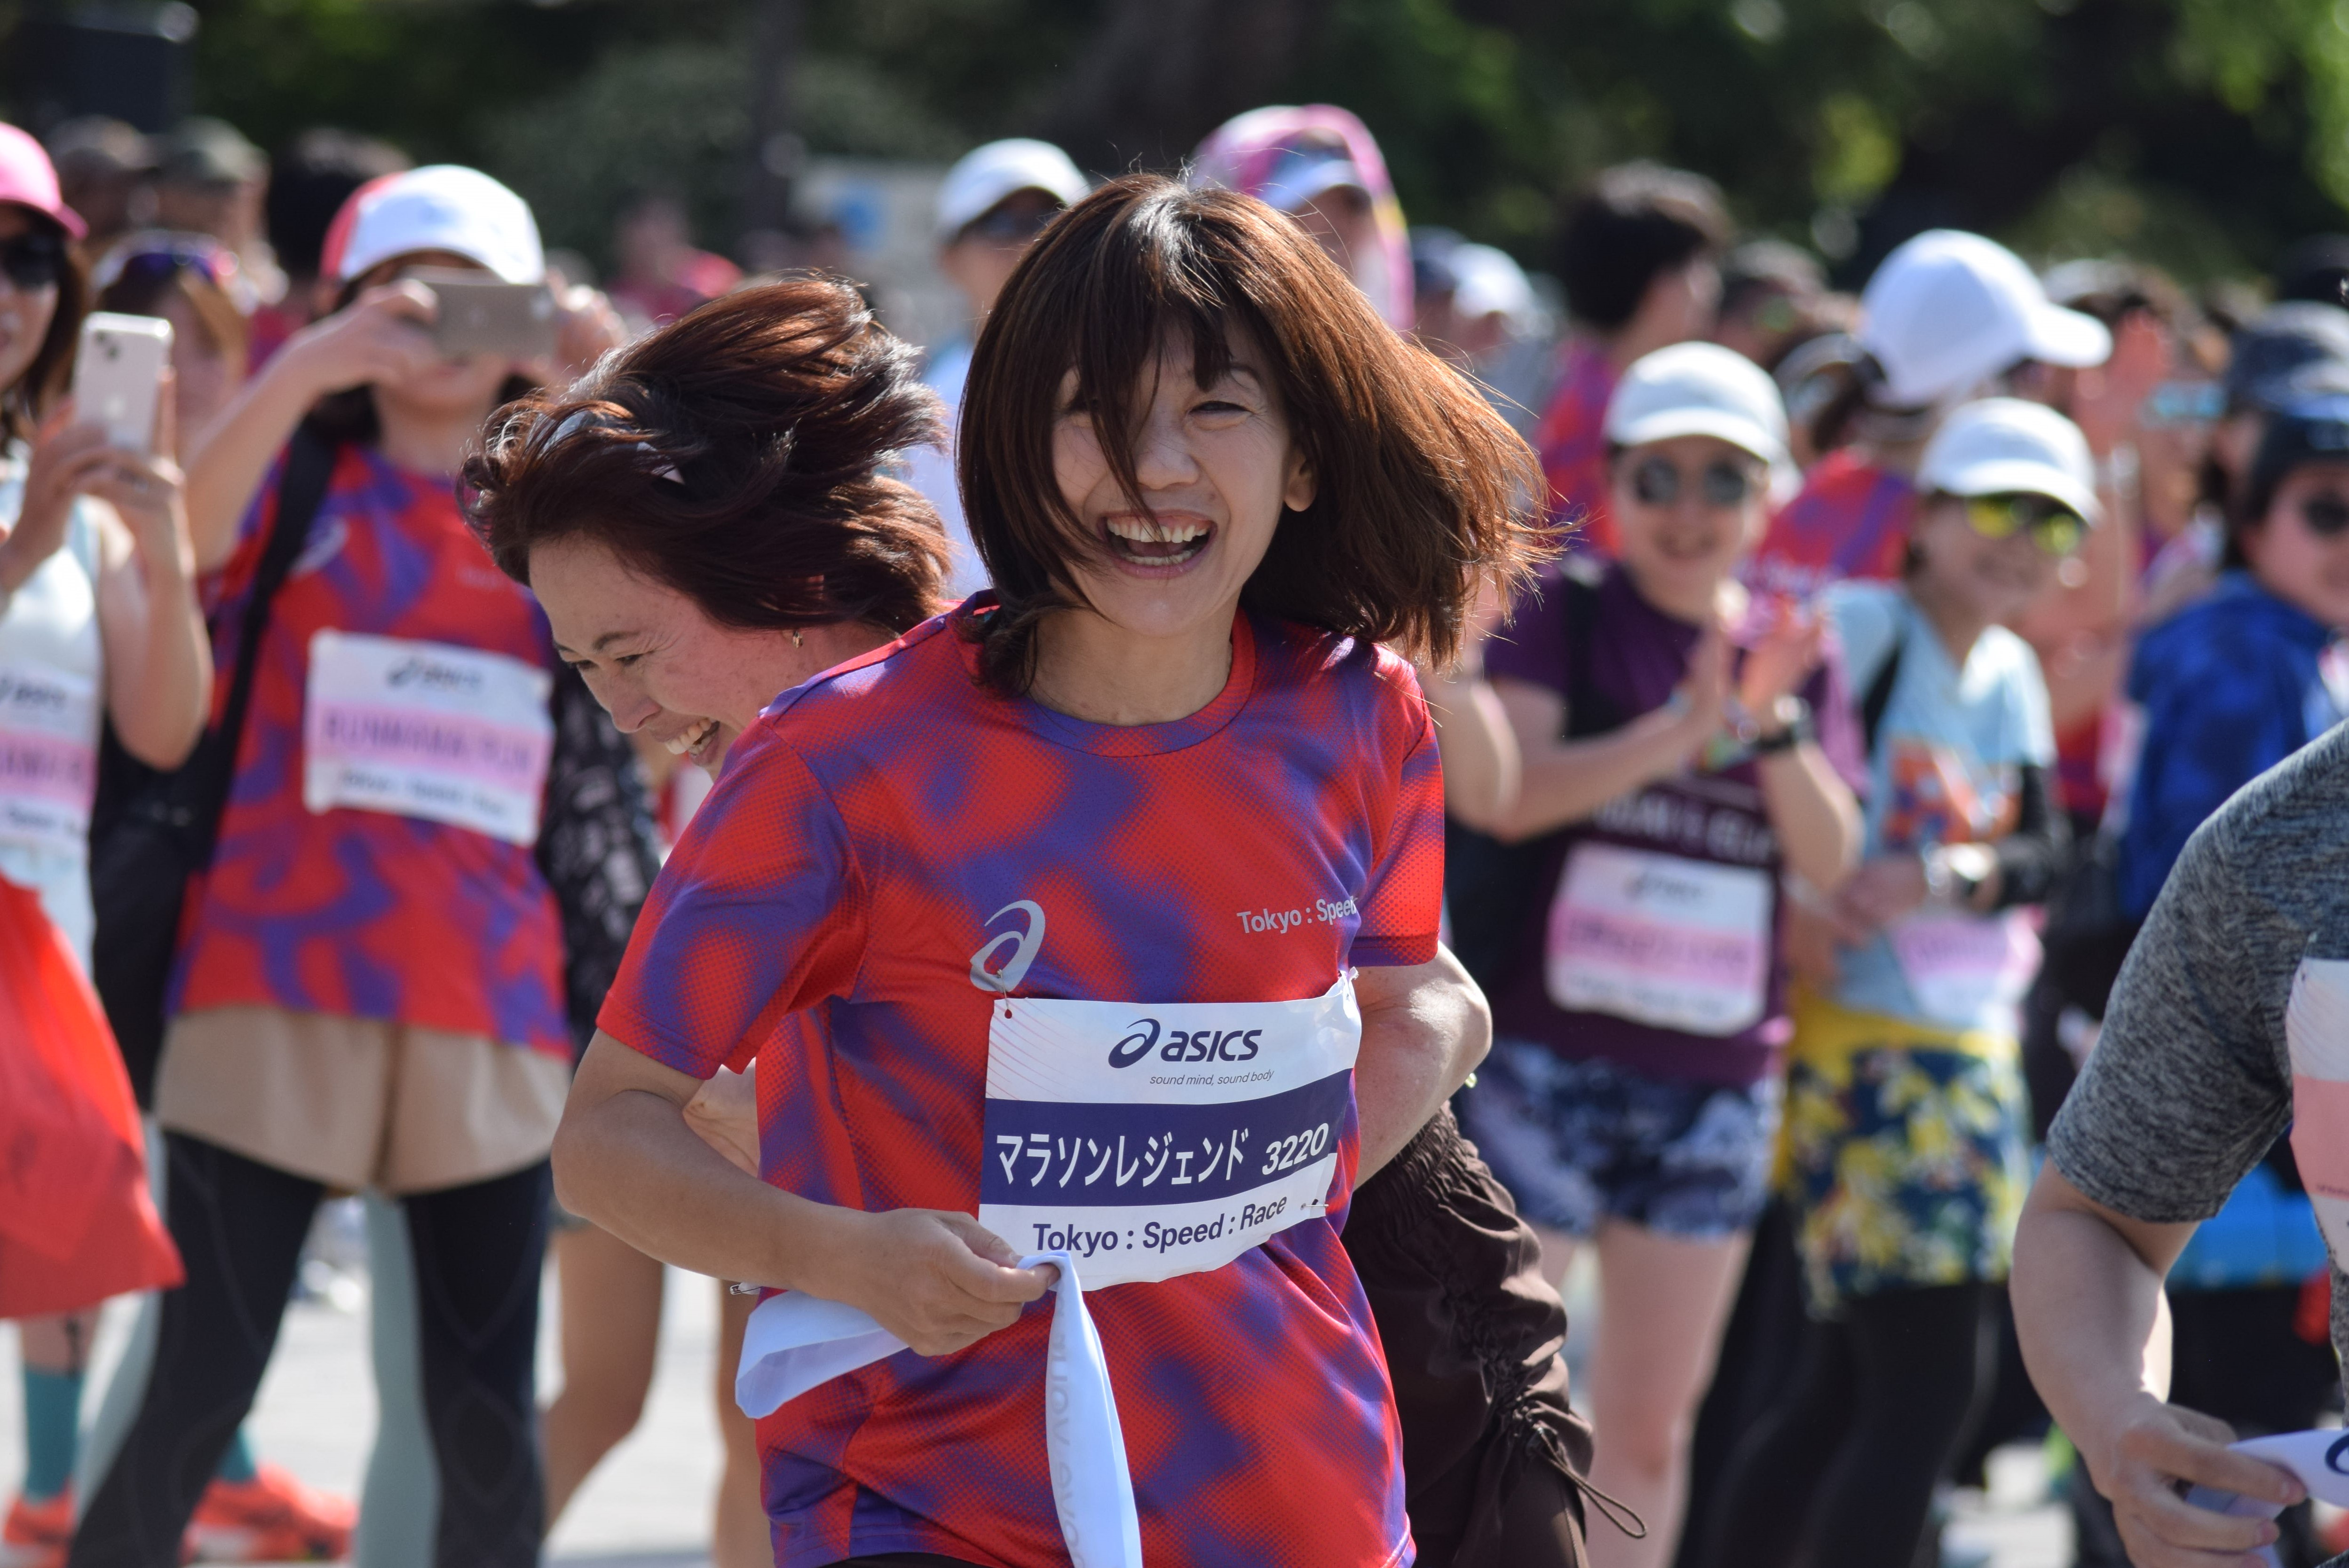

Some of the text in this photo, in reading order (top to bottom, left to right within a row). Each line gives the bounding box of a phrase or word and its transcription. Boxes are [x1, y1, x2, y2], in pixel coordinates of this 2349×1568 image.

[1236, 908, 1302, 934] Tokyo
[1150, 1069, 1274, 1086] sound mind, sound body
[996, 1122, 1329, 1189] マラソンレジェンド 3220
[1032, 1223, 1119, 1258] Tokyo
[1142, 1213, 1225, 1253] Speed
[1240, 1196, 1288, 1231] Race
